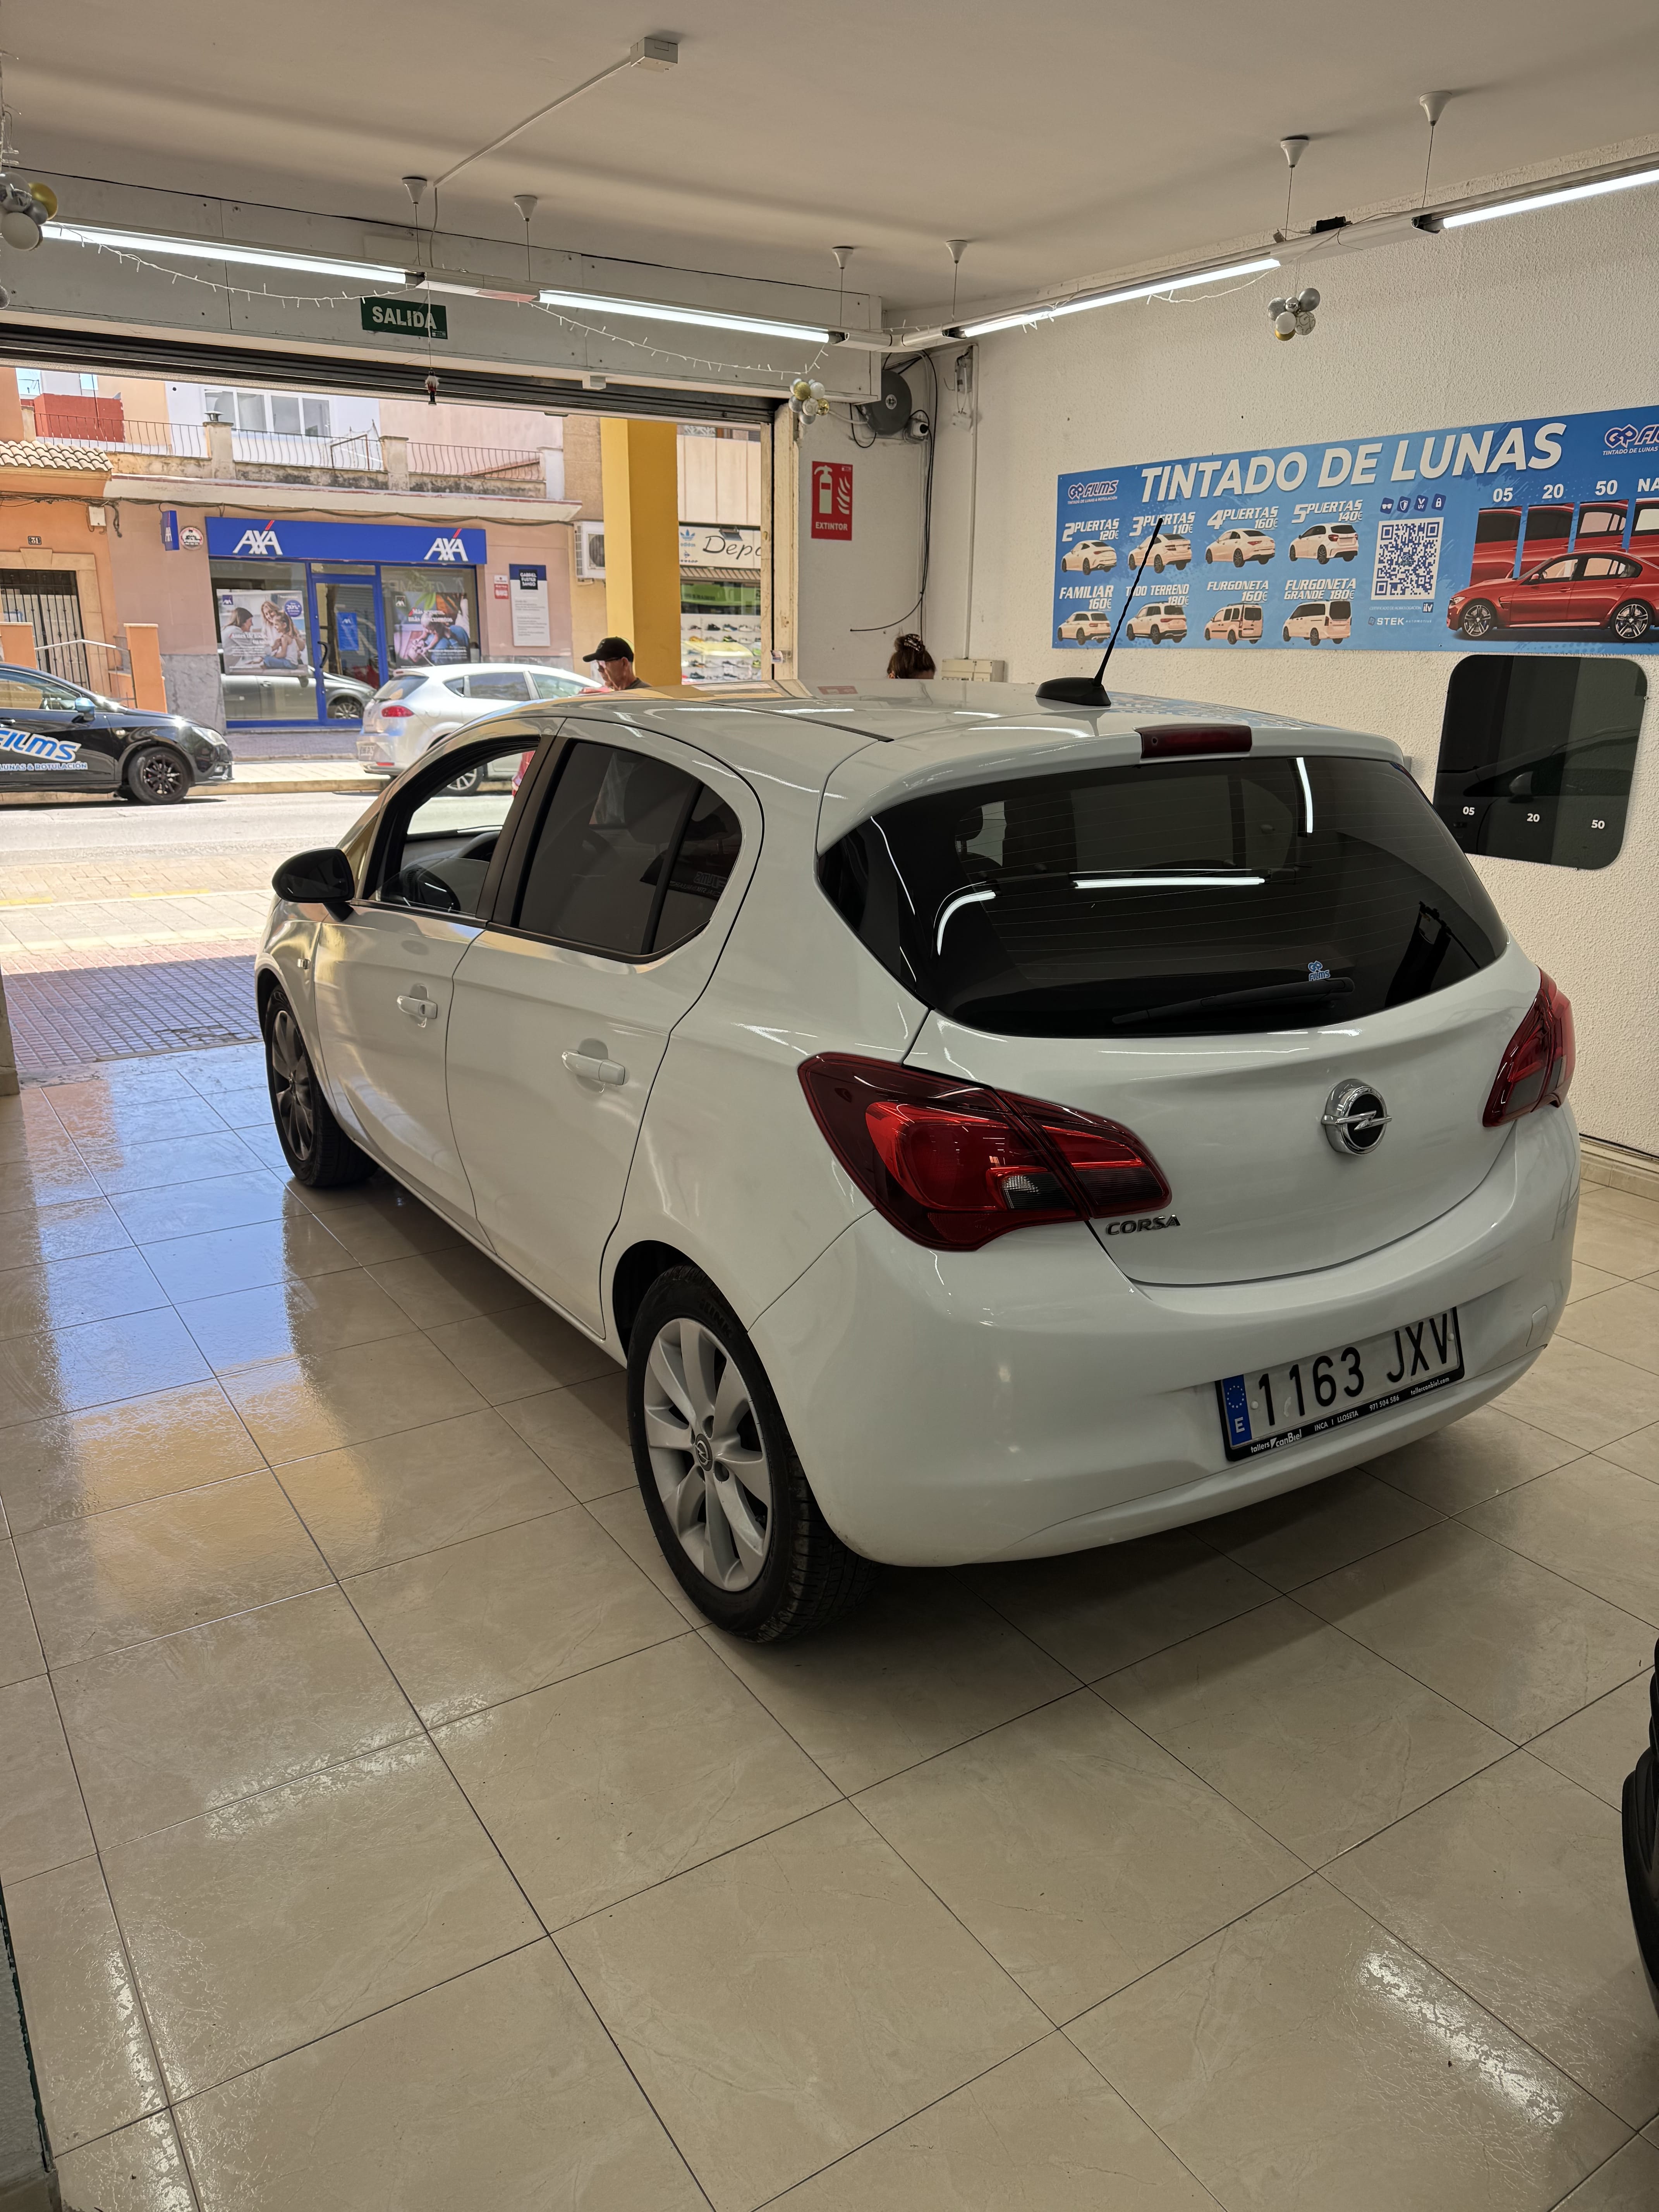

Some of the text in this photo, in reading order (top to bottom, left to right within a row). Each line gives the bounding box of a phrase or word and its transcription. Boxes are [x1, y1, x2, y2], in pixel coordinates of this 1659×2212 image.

[372, 306, 437, 329] SALIDA
[1634, 424, 1659, 445] FI
[1141, 423, 1567, 503] TINTADO DE LUNAS
[1083, 480, 1119, 498] FILMS
[1542, 484, 1565, 499] 20
[1595, 480, 1618, 496] 50
[1493, 488, 1514, 502] 05
[1338, 511, 1363, 522] 140€
[815, 522, 848, 531] EXTINTOR
[1173, 524, 1193, 534] 110€
[1255, 518, 1278, 529] 160€
[1099, 530, 1119, 540] 120€
[233, 530, 283, 555] AXA
[424, 538, 468, 562] AXA
[1150, 584, 1190, 596] TERRENO
[1207, 580, 1269, 591] FURGONETA
[1285, 578, 1356, 591] FURGONETA
[1059, 585, 1114, 599] FAMILIAR
[1242, 591, 1268, 601] 160€
[1284, 590, 1355, 600] GRANDE 180€
[1089, 599, 1112, 610] 160€
[1168, 596, 1189, 606] 180€
[1377, 617, 1405, 625] STEK
[34, 761, 88, 771] ROTULACIÓN
[1462, 806, 1475, 816] 05
[1527, 813, 1540, 823] 20
[1591, 819, 1605, 829] 50
[1309, 969, 1331, 982] FILMS
[1106, 1214, 1181, 1235] CORSA
[1259, 1313, 1448, 1426] 1163 JXV
[1250, 1442, 1270, 1453] tallers
[1314, 1422, 1329, 1432] INCA
[1337, 1410, 1359, 1423] LLOSETA
[1369, 1402, 1379, 1411] 971
[1379, 1399, 1389, 1408] 504
[1390, 1395, 1400, 1404] 586
[1411, 1377, 1449, 1396] tallercanbiel.com
[1235, 1417, 1245, 1433] E
